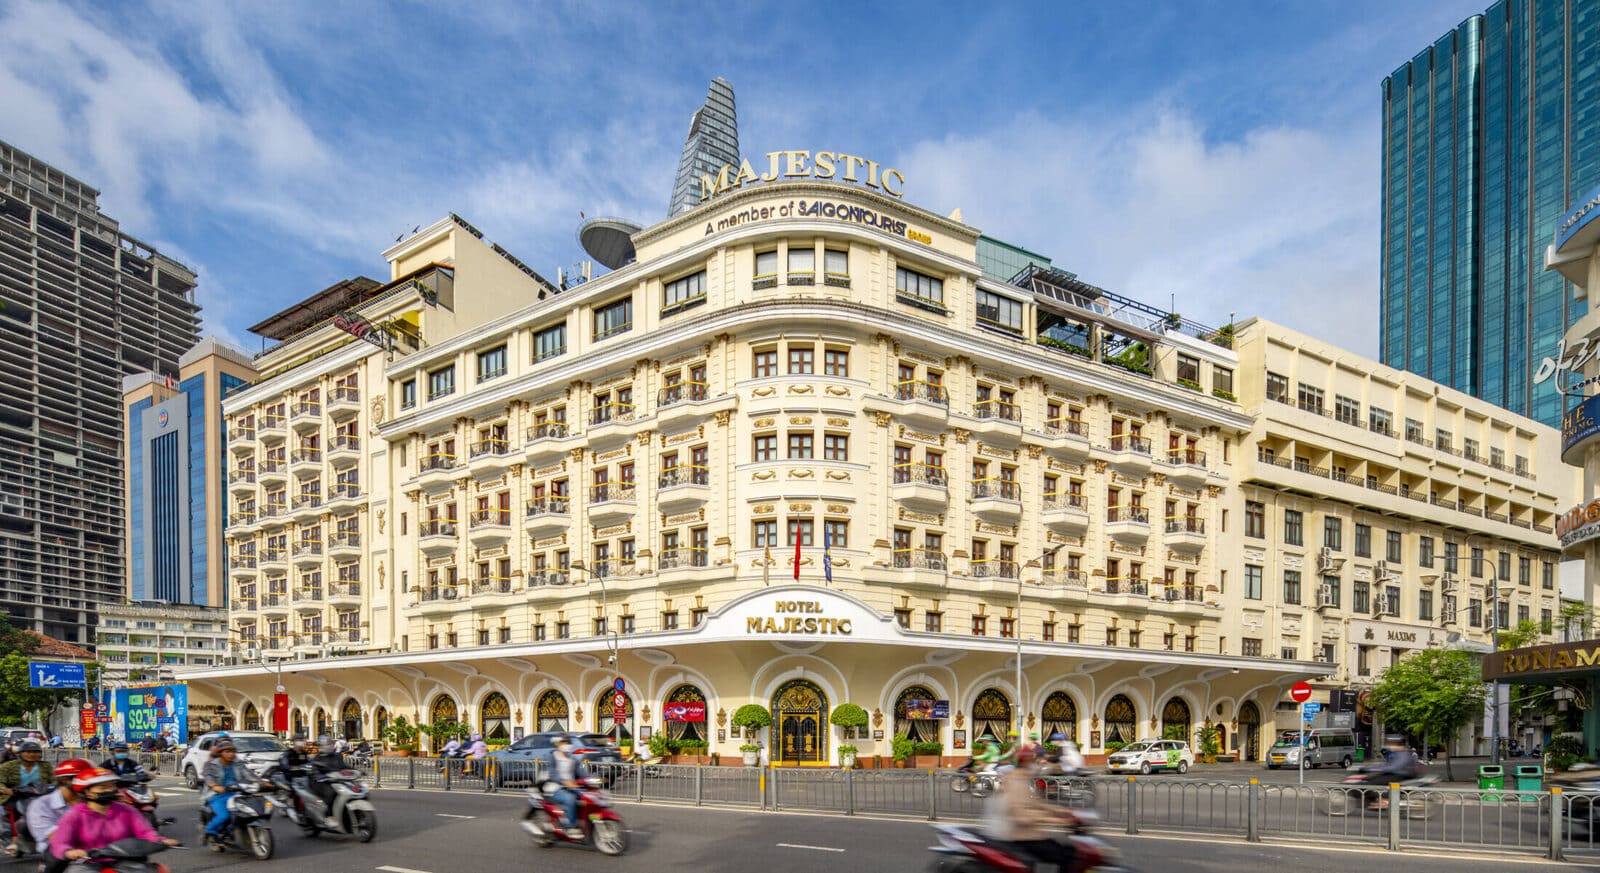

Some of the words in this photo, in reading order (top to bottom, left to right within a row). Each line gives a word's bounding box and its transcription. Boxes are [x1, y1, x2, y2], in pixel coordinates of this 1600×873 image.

[700, 150, 905, 201] MAJESTIC
[704, 222, 715, 237] A
[717, 204, 775, 232] member
[779, 201, 795, 217] of
[798, 200, 907, 237] SAIGONTOURIST
[775, 600, 823, 613] HOTEL
[746, 617, 853, 635] MAJESTIC
[1503, 647, 1600, 673] RUNAM
